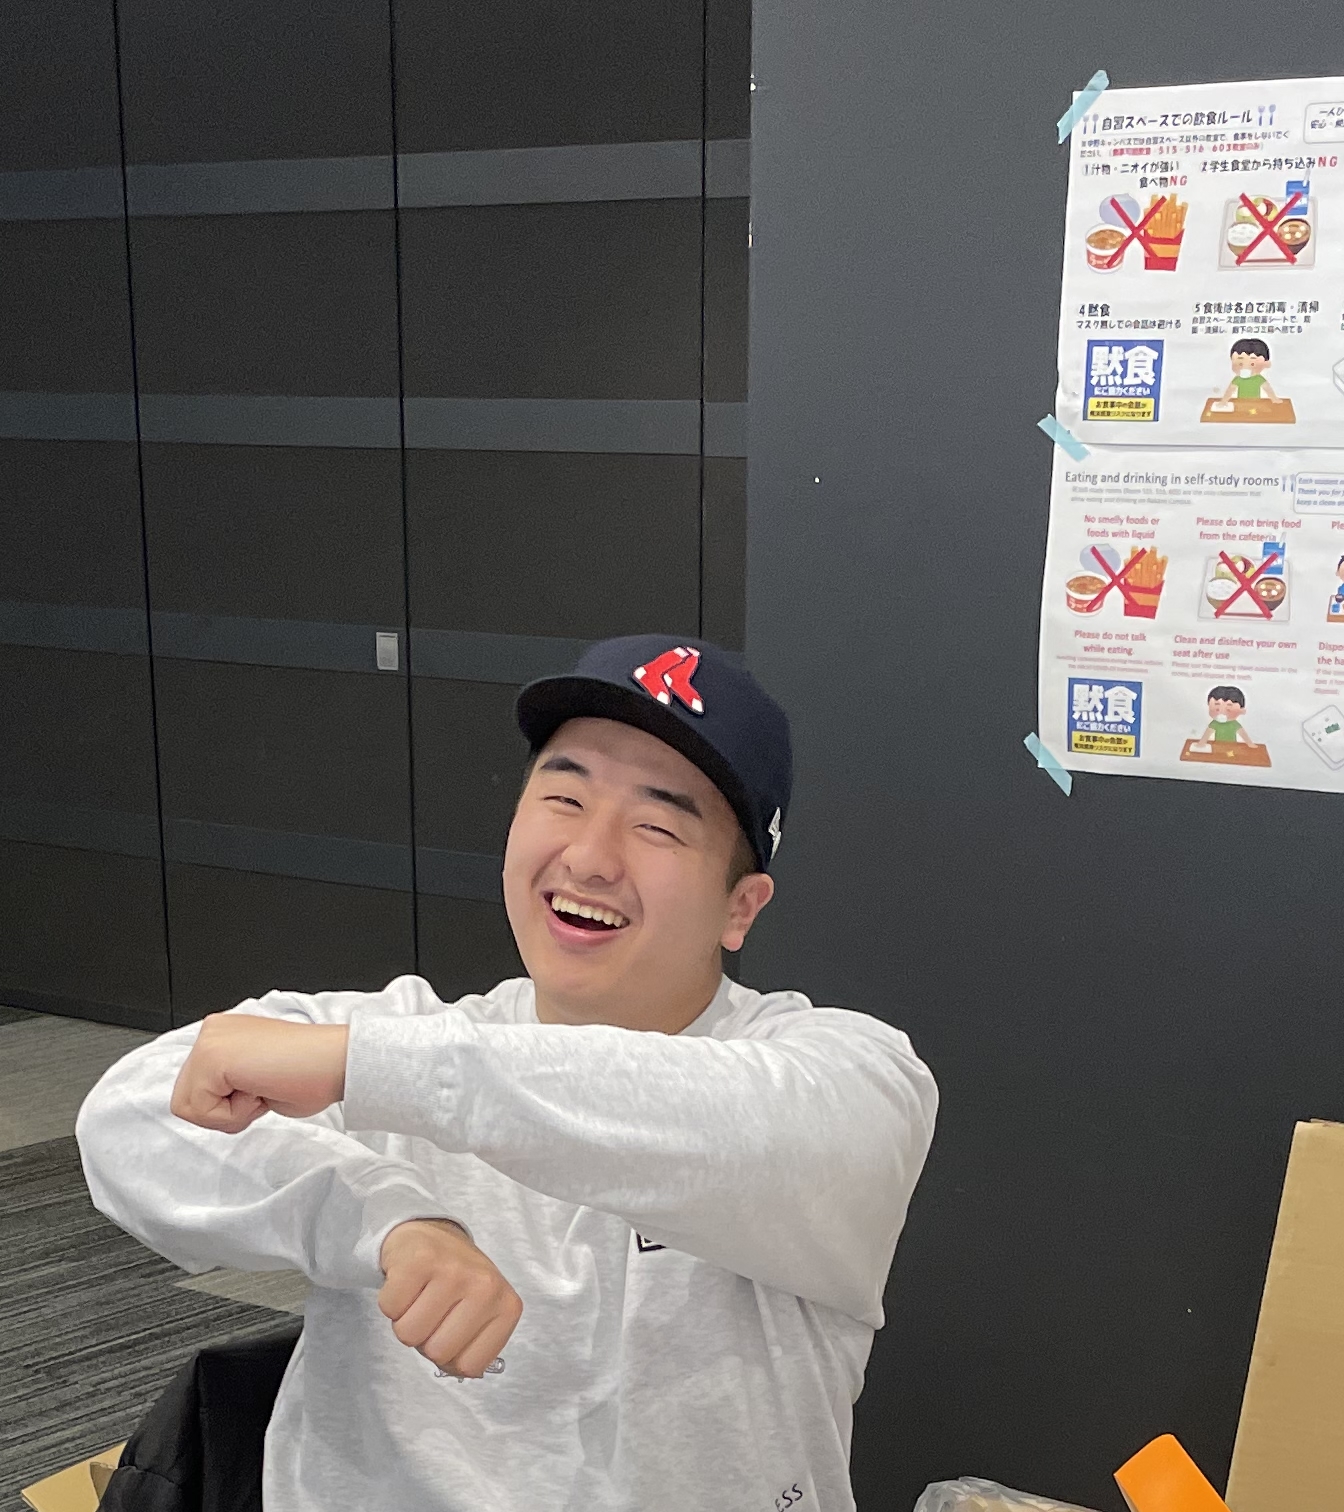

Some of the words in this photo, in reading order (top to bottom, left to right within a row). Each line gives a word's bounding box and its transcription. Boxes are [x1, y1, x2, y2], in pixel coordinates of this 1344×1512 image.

[1101, 110, 1253, 131] 自習スペースでの飲食ルール
[1090, 346, 1159, 386] 黙食
[1065, 471, 1098, 485] Eating
[1101, 472, 1120, 483] and
[1123, 472, 1168, 487] drinking
[1171, 474, 1181, 485] in
[1184, 474, 1240, 488] self-study
[1243, 477, 1280, 487] rooms
[1084, 515, 1096, 523] No
[1098, 516, 1124, 526] smelly
[1126, 516, 1148, 525] foods
[1196, 517, 1224, 527] Please
[1226, 518, 1237, 527] do
[1240, 519, 1254, 528] not
[1257, 519, 1279, 529] bring
[1281, 519, 1302, 528] food
[1087, 529, 1109, 538] foods
[1111, 530, 1130, 539] with
[1132, 530, 1155, 540] liquid
[1199, 532, 1220, 540] from
[1222, 532, 1236, 541] the
[1238, 532, 1277, 542] cafeteria
[1074, 630, 1099, 640] Please
[1102, 632, 1113, 640] do
[1115, 632, 1129, 641] not
[1131, 632, 1147, 641] talk
[1174, 635, 1197, 645] Clean
[1199, 636, 1215, 645] and
[1218, 637, 1254, 647] disinfect
[1256, 640, 1276, 650] your
[1278, 640, 1297, 649] own
[1083, 644, 1105, 653] while
[1173, 649, 1191, 657] seat
[1192, 649, 1213, 659] after
[1215, 651, 1230, 660] use
[1317, 656, 1332, 665] the
[1072, 684, 1137, 723] 黙食
